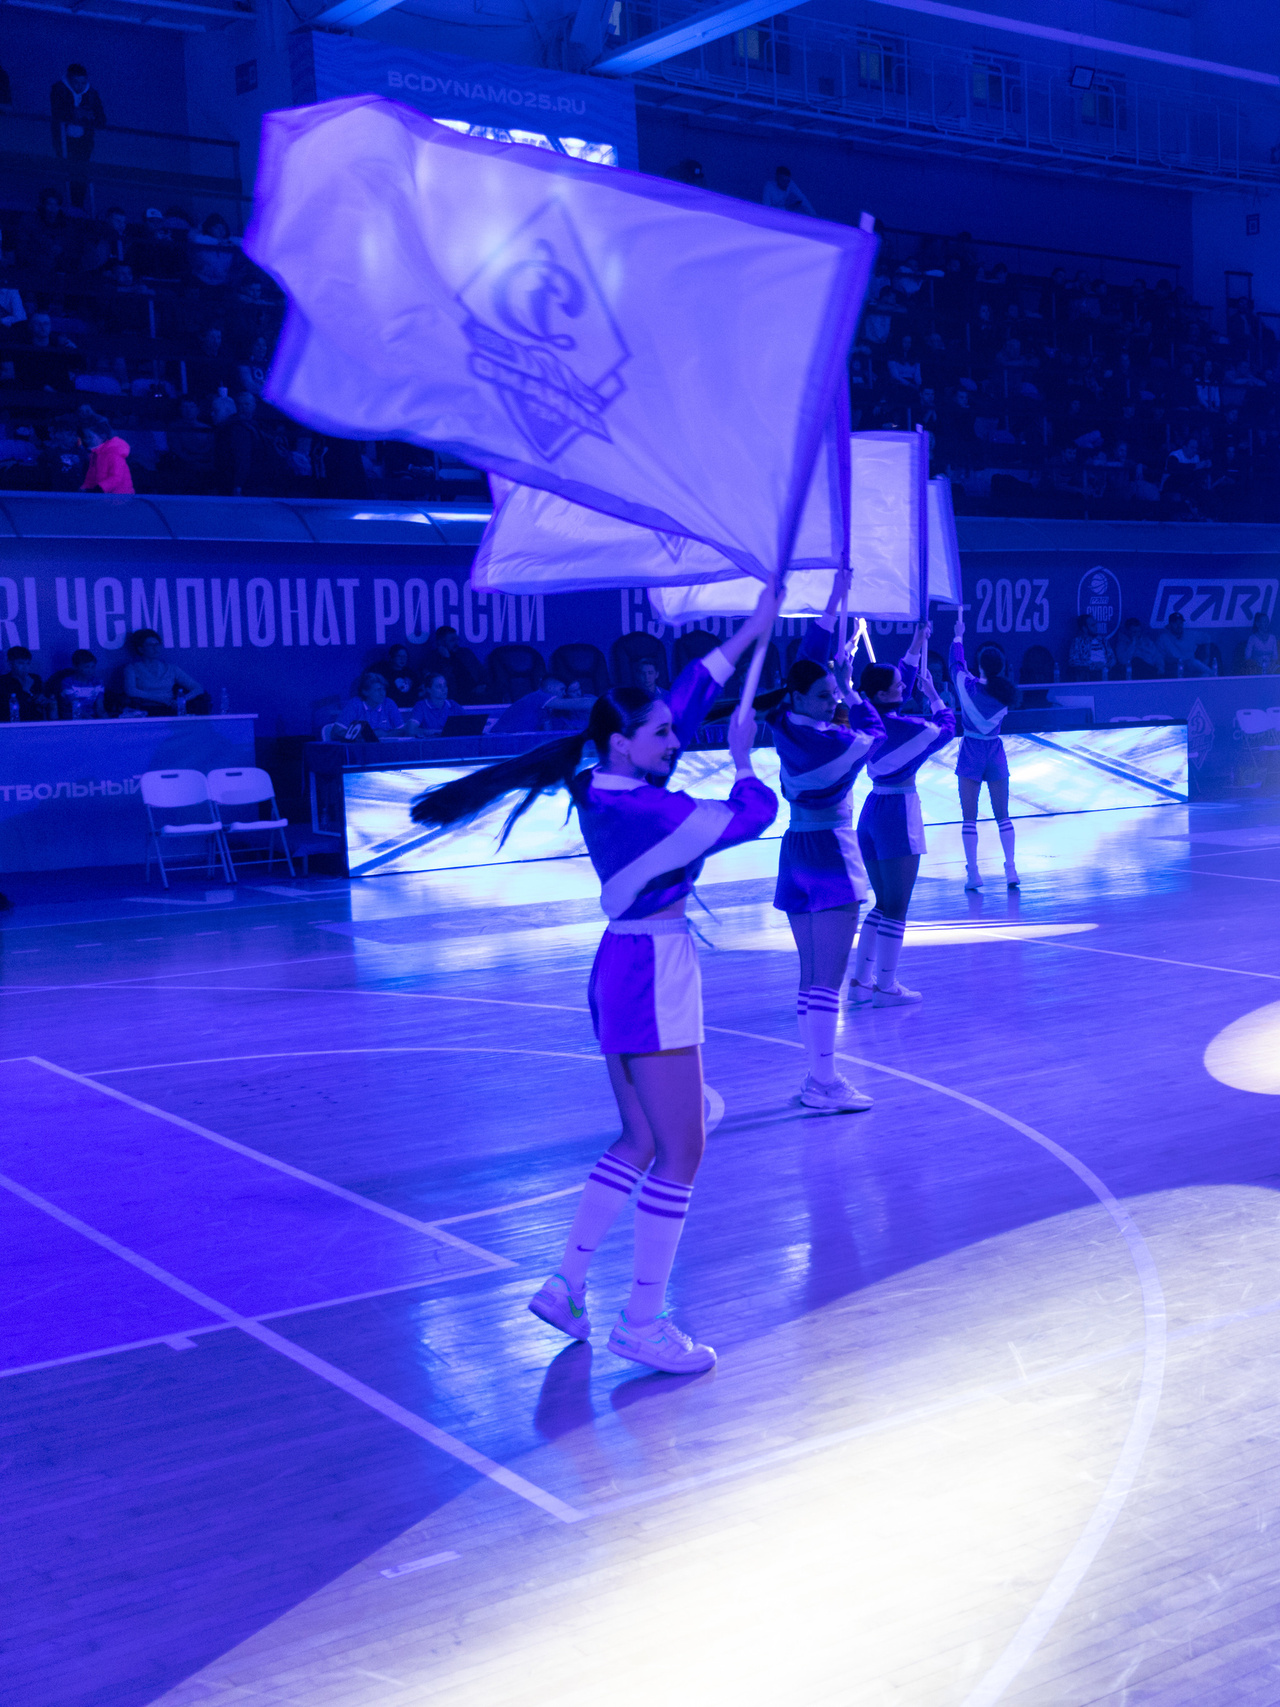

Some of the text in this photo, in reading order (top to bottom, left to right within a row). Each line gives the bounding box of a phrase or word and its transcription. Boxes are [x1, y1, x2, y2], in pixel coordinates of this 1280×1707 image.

[387, 70, 587, 116] BCDYNAMO25.RU
[55, 577, 360, 651] ЧЕМПИОНАТ
[975, 578, 1051, 633] 2023
[1156, 584, 1274, 622] PARI
